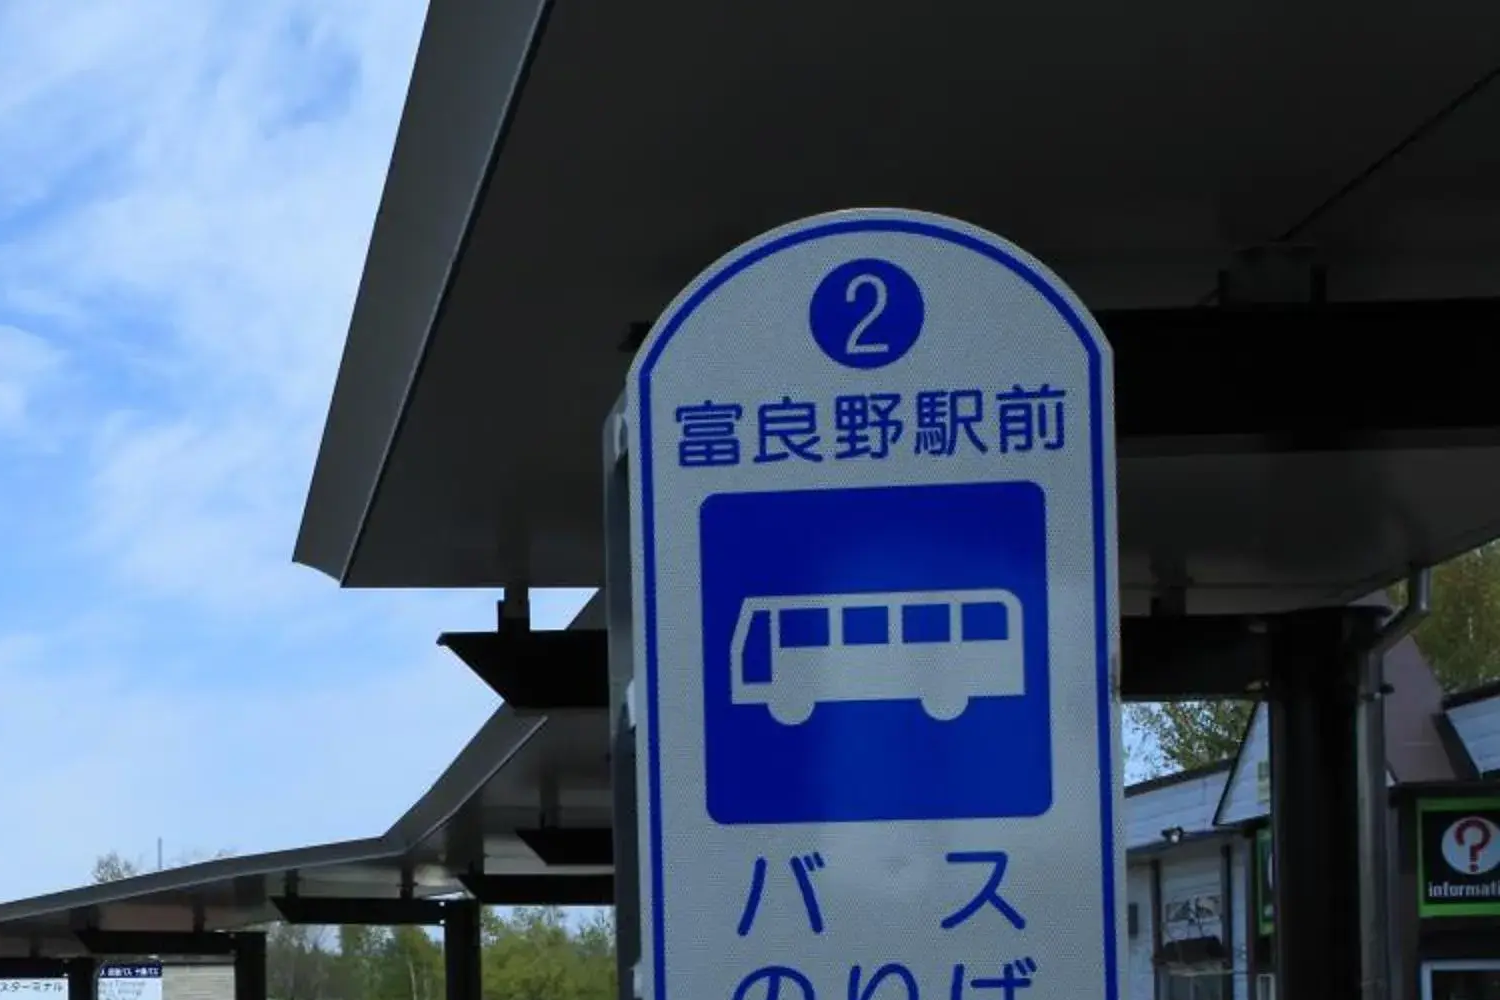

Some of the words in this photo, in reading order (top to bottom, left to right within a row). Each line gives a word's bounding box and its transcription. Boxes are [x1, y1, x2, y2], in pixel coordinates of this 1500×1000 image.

[845, 273, 889, 355] 2
[675, 383, 1066, 467] 富良野駅前
[737, 851, 1026, 936] バス
